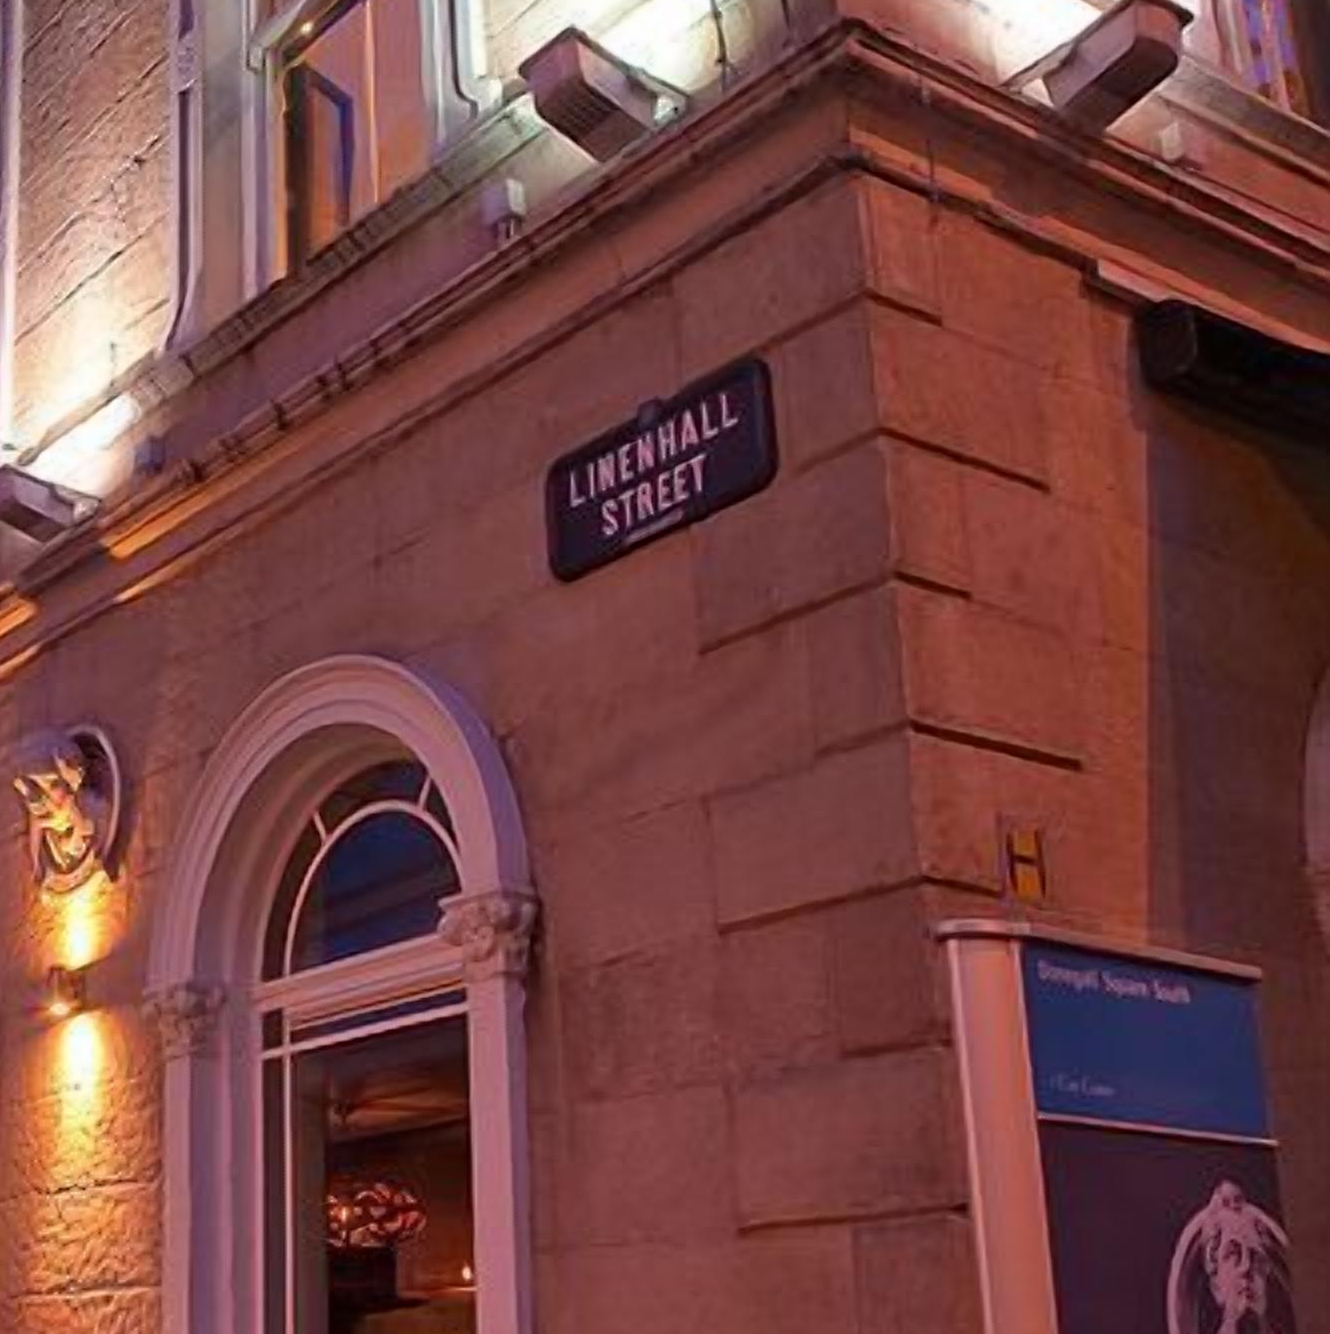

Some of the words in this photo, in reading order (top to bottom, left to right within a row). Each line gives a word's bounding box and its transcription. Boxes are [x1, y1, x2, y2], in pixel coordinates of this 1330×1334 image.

[570, 393, 739, 508] LINENHALL
[601, 454, 707, 536] STREET
[1006, 830, 1047, 899] H
